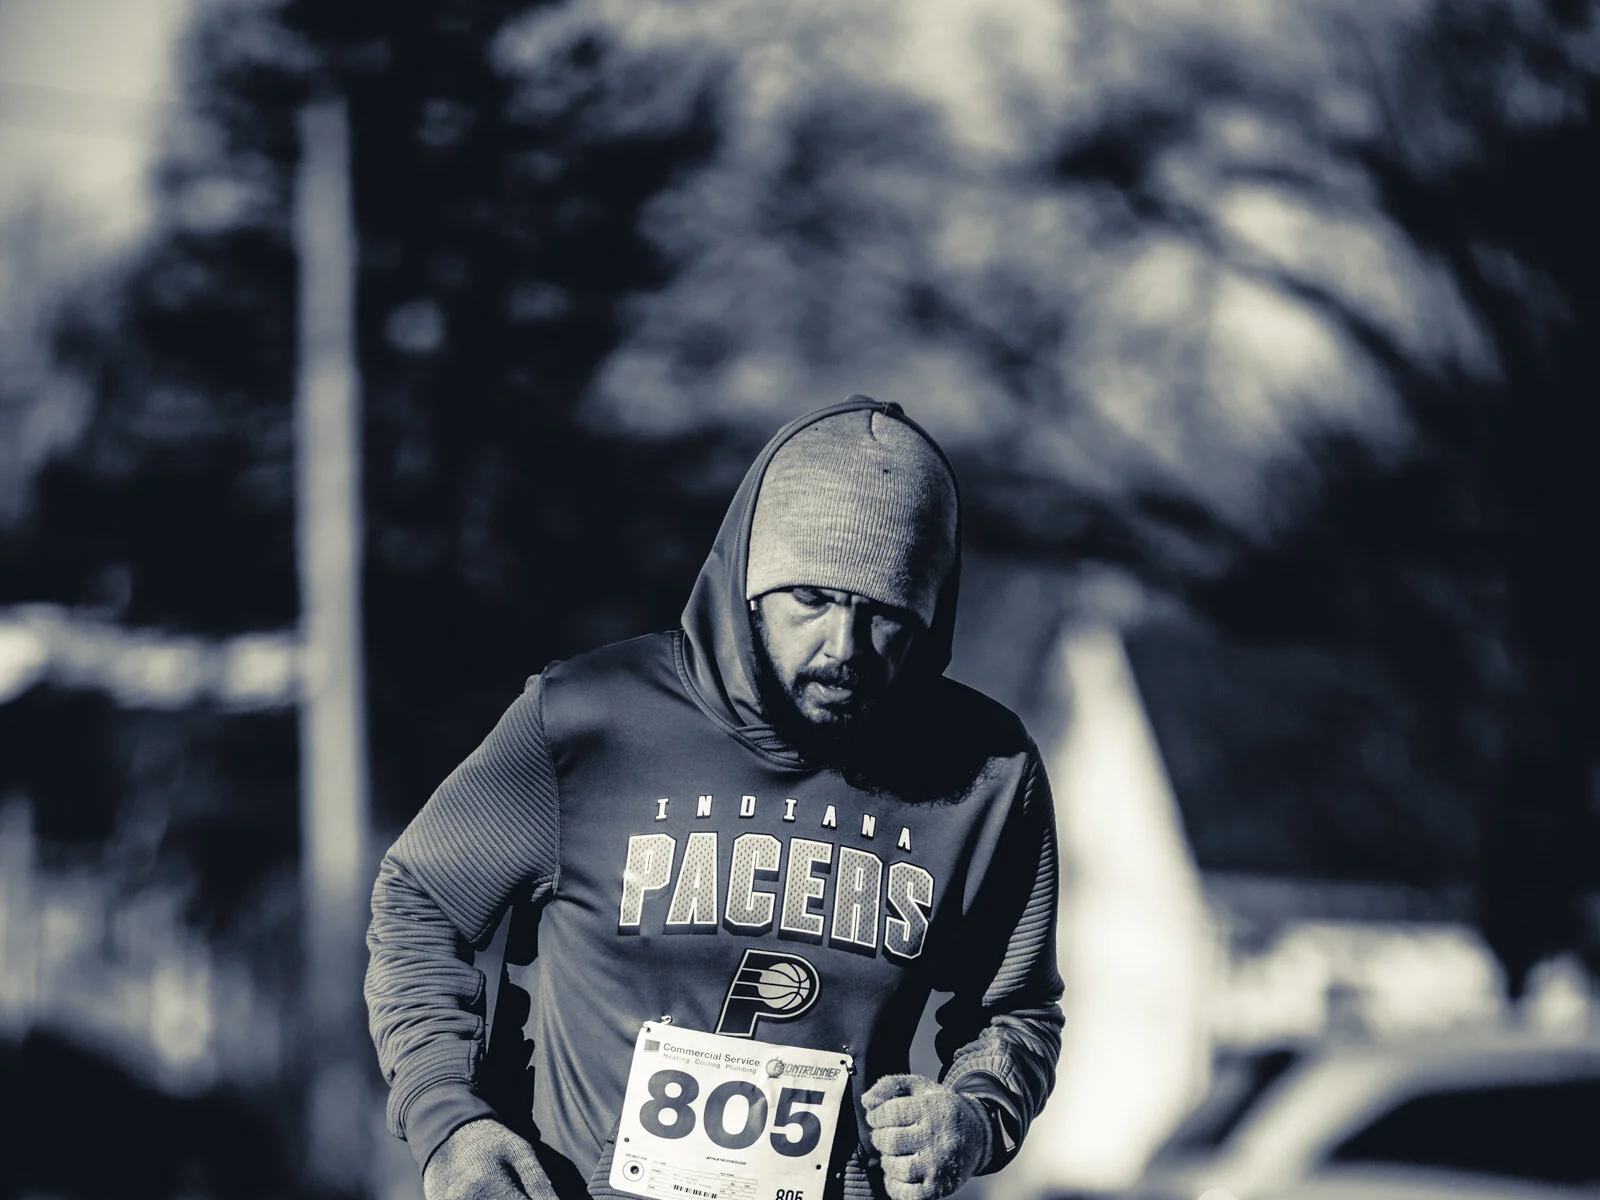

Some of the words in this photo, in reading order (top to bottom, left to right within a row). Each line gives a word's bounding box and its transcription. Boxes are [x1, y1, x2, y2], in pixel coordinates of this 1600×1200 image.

[655, 795, 911, 853] INDIANA
[618, 832, 935, 965] PACERS
[663, 1043, 722, 1061] Commercial
[724, 1054, 761, 1066] Service
[663, 1053, 690, 1064] Heating
[694, 1058, 721, 1069] Cooling
[725, 1064, 757, 1075] Plumbing
[639, 1069, 825, 1158] 805
